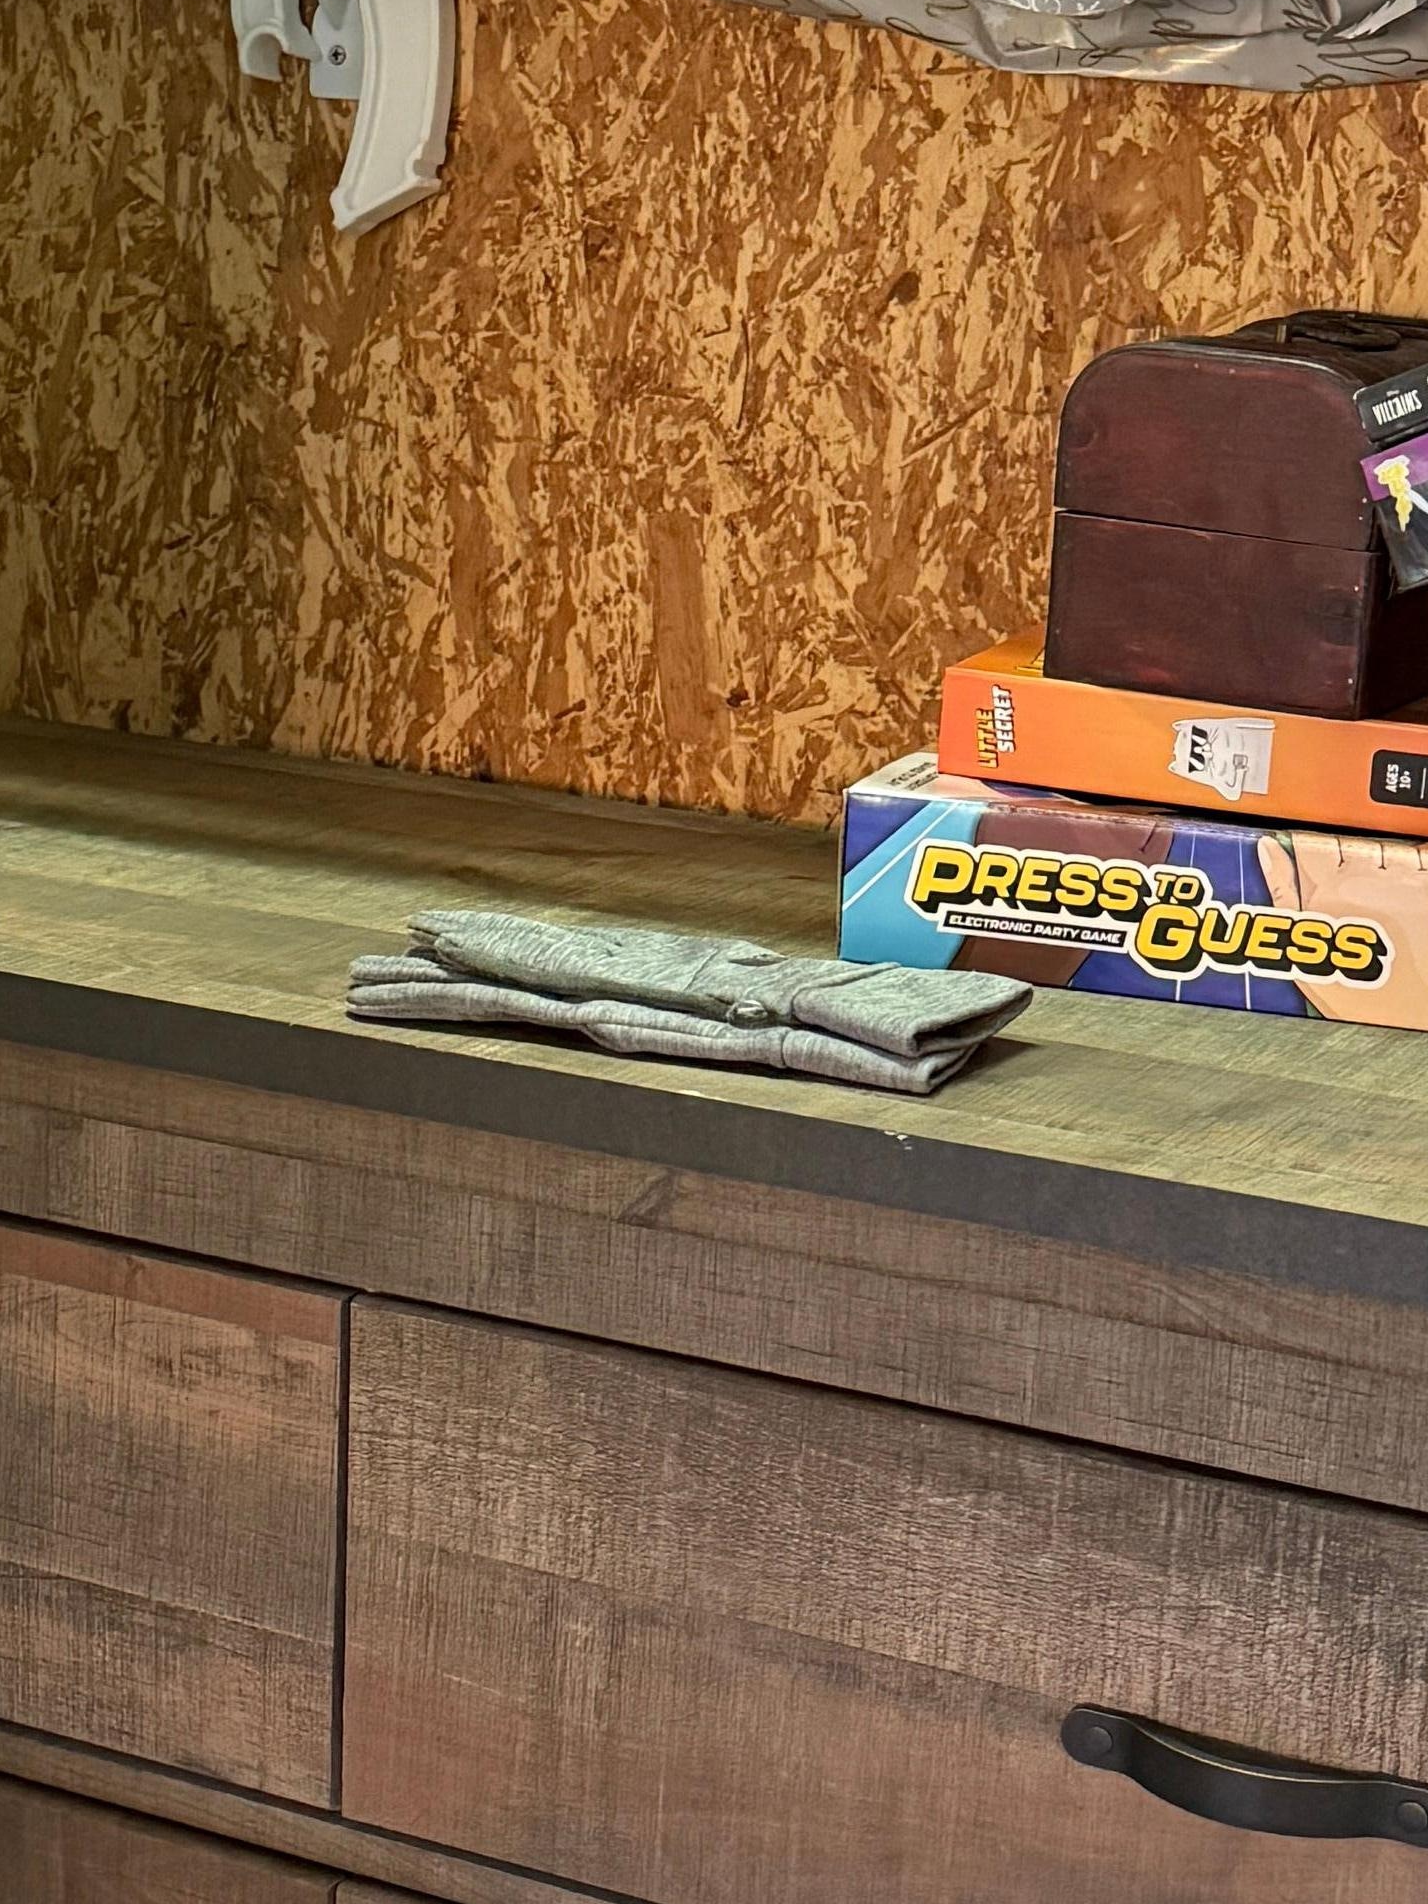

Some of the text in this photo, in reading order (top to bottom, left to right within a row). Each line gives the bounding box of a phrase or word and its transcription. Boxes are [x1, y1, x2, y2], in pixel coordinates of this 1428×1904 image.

[1371, 388, 1423, 426] VILLAINS
[975, 708, 998, 769] LITTLE
[992, 684, 1015, 754] SECRET
[1385, 763, 1400, 793] AGES
[912, 845, 1200, 912] PRESS TO
[948, 914, 1123, 946] ELECTRONIC PARTY GAME
[1136, 904, 1380, 972] GUESS
